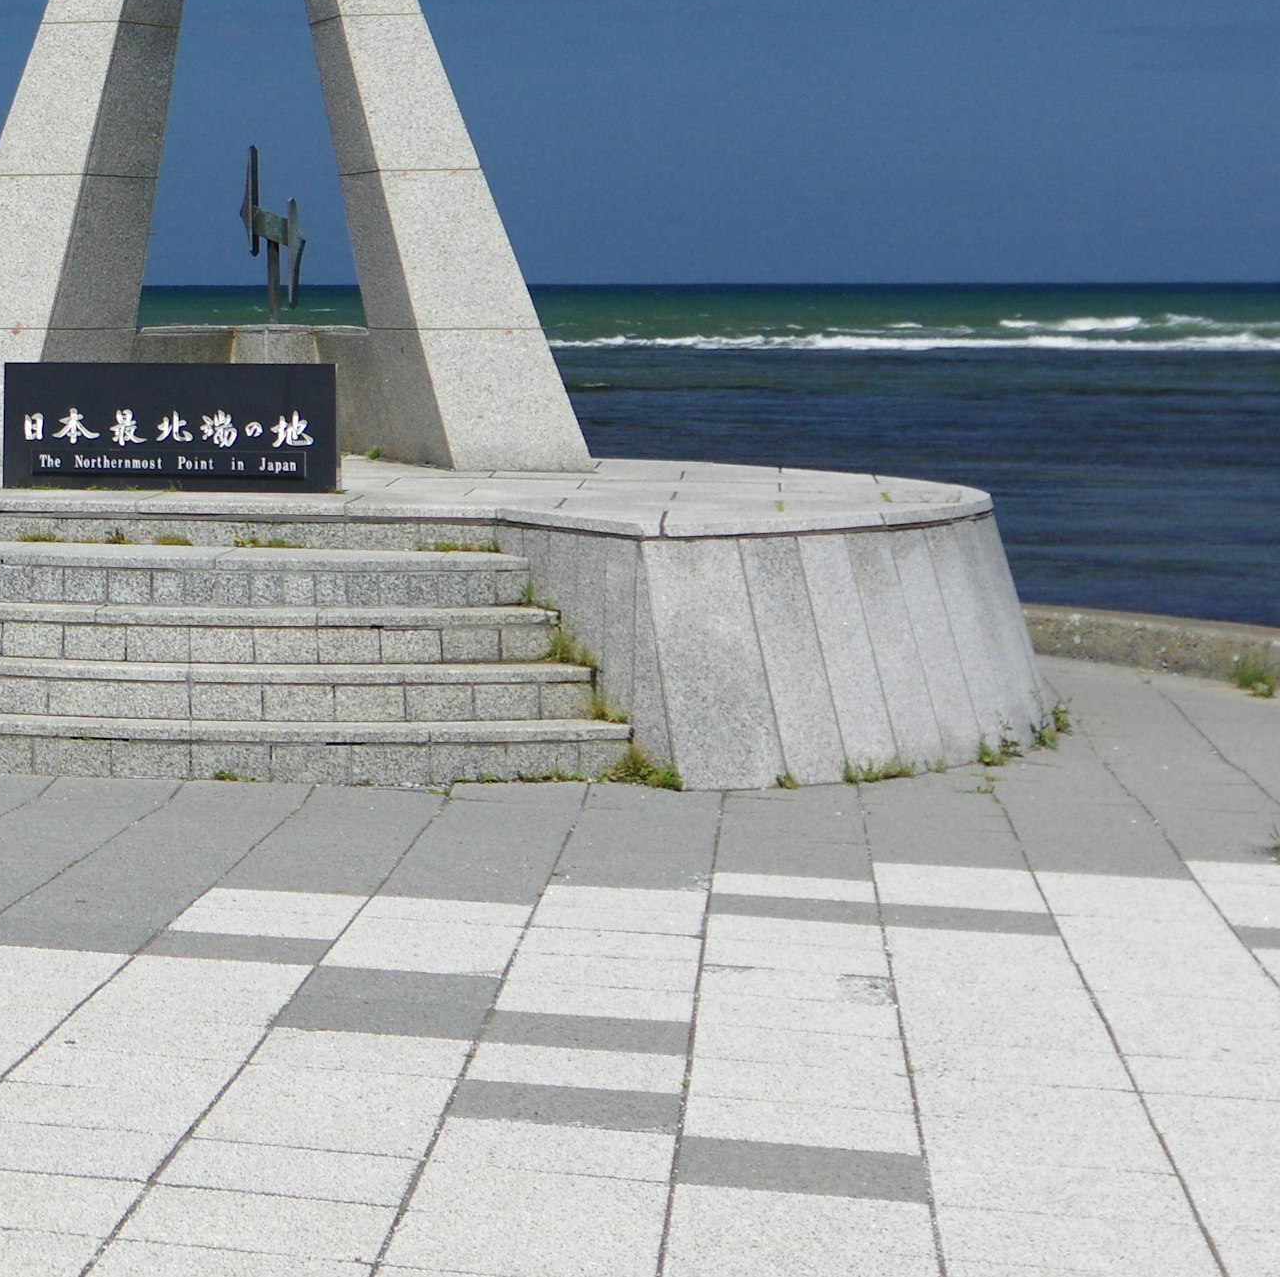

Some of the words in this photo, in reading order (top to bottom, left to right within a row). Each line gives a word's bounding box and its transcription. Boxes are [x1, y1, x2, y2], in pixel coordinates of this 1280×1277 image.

[23, 407, 315, 448] 日本最北端の地
[39, 454, 61, 469] The
[74, 454, 163, 470] Northernmost
[177, 456, 214, 471] Point
[231, 456, 245, 471] in
[259, 458, 297, 474] Japan
